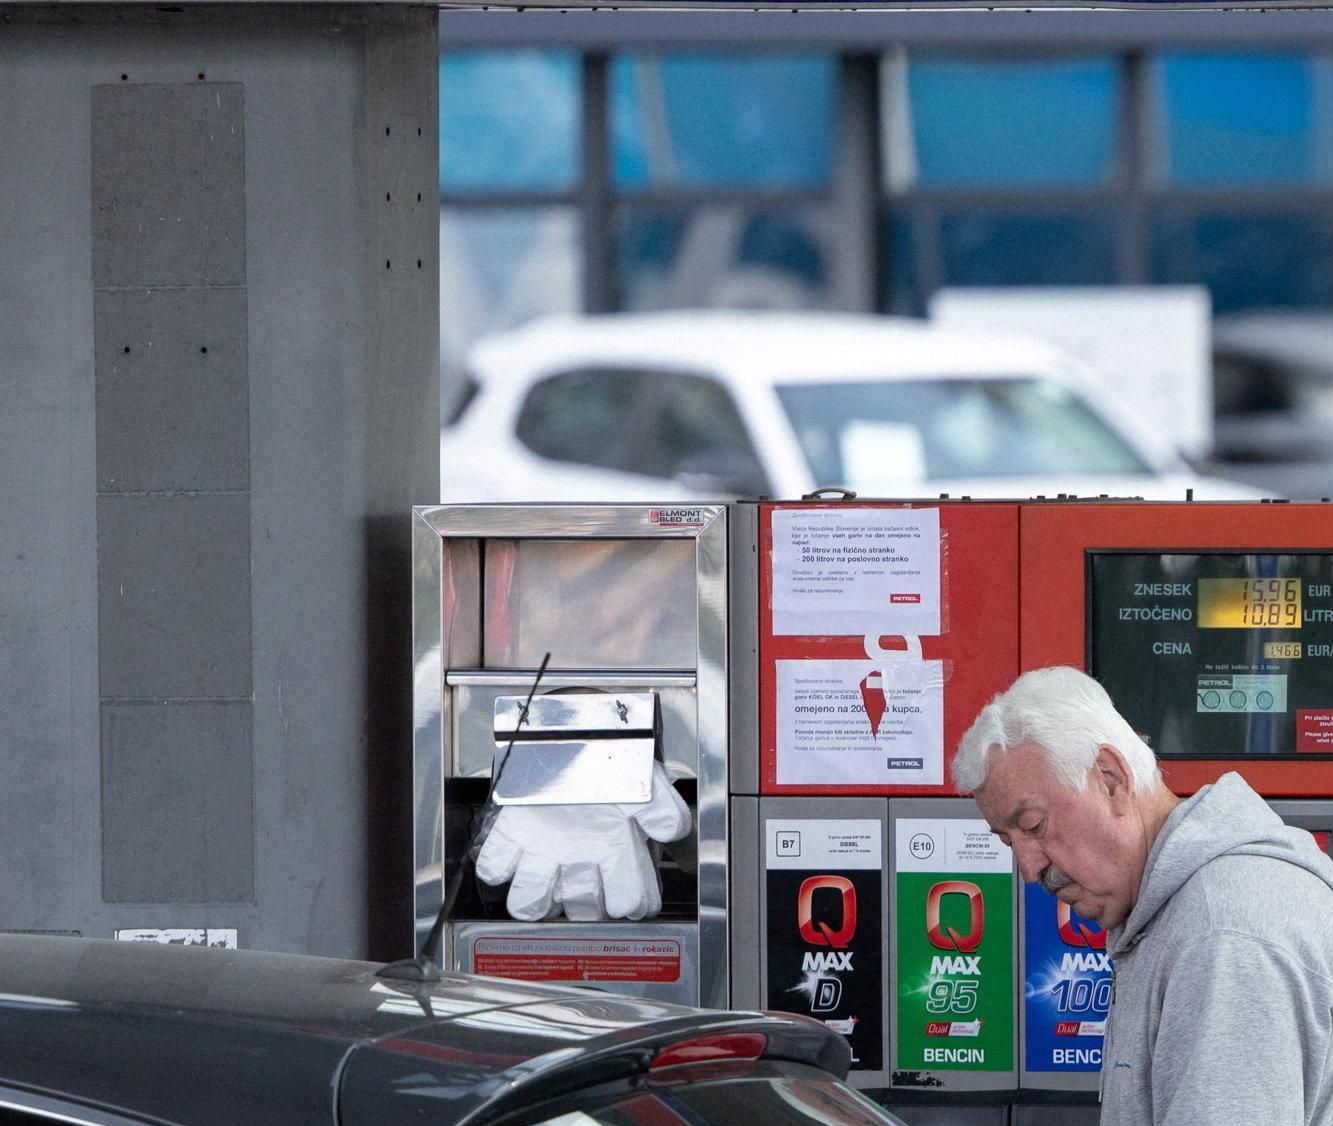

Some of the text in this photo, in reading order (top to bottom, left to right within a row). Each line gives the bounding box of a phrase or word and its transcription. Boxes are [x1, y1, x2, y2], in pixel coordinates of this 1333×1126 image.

[1134, 580, 1331, 602] ZNESEK 15,96 EUR
[1119, 605, 1192, 621] IZTOČENO
[1242, 603, 1297, 626] 10,89
[1152, 642, 1192, 654] CENA
[794, 706, 834, 714] omejeno
[892, 705, 922, 714] kupca,
[782, 839, 795, 849] B7
[913, 841, 931, 851] E10
[798, 874, 857, 948] Q
[926, 881, 984, 953] Q
[642, 945, 674, 953] rokavic
[802, 952, 854, 971] MAX
[930, 956, 981, 975] MAX
[1060, 953, 1113, 972] MAX
[810, 977, 842, 1012] D
[925, 979, 979, 1014] 95
[1051, 978, 1112, 1012] 100
[928, 1023, 948, 1034] Dual
[1056, 1023, 1077, 1034] Dual
[924, 1048, 984, 1063] BENCIN
